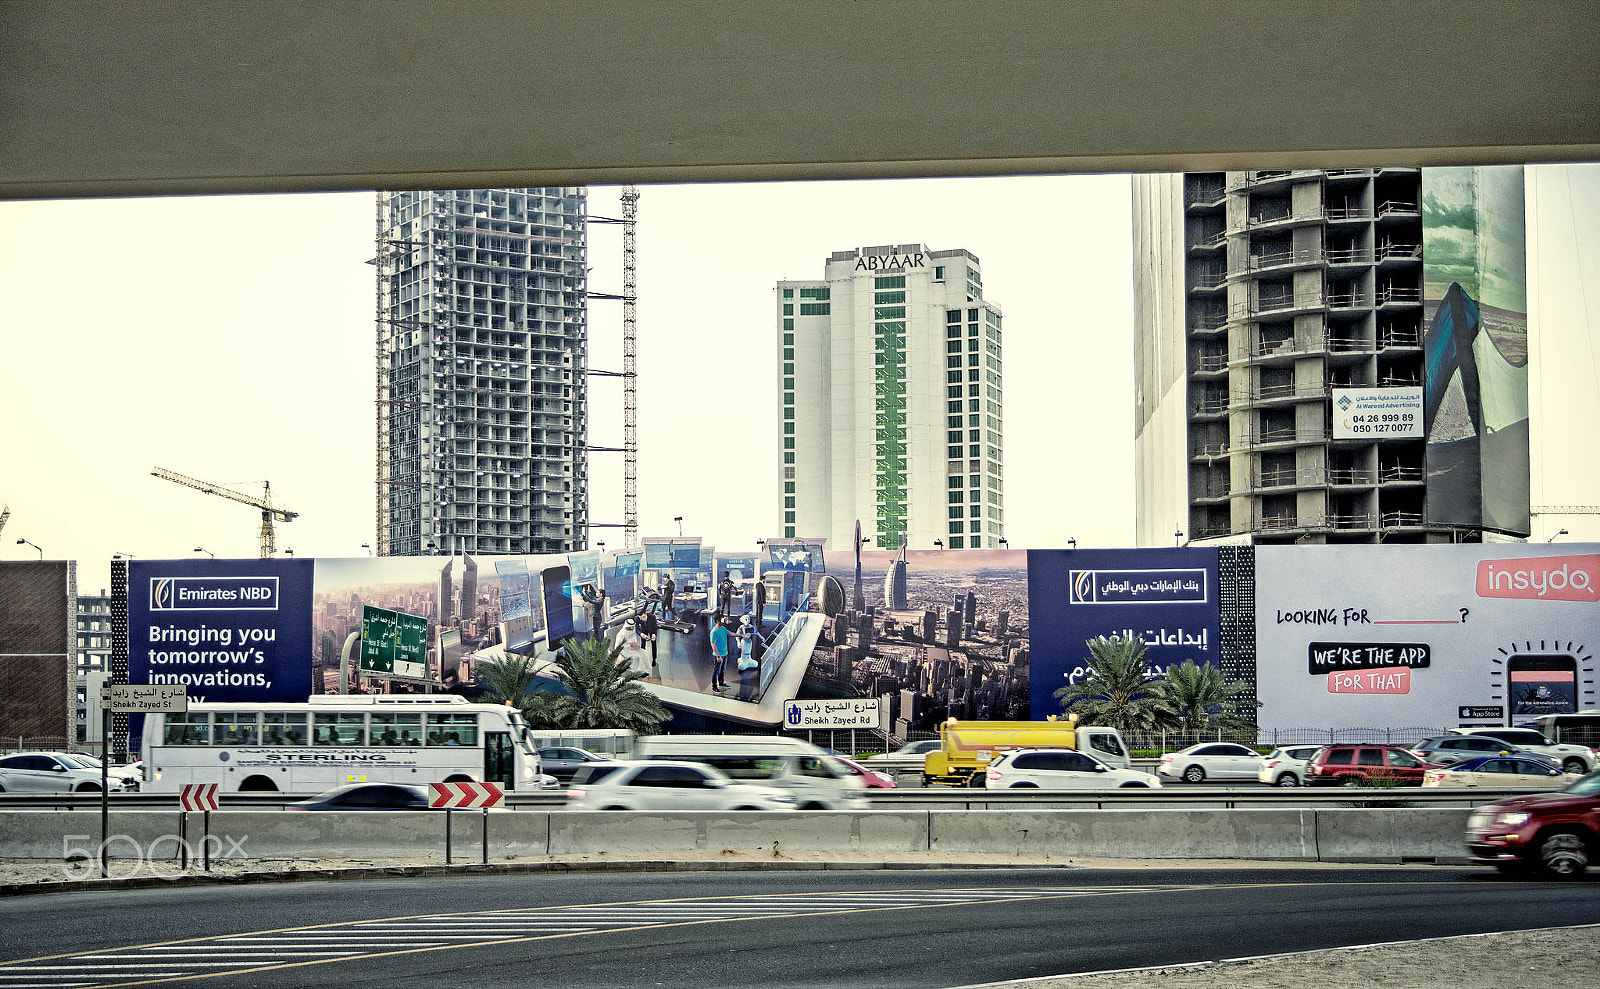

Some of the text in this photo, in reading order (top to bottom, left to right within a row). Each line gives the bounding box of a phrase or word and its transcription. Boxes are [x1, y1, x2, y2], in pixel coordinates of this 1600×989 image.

[855, 253, 925, 271] ABYAAR
[1352, 413, 1414, 423] 04 26 999 89
[1352, 423, 1414, 433] 050 127 0077
[1101, 579, 1199, 596] بنك الإمارات دبي الوطني
[1488, 563, 1595, 597] insydo
[179, 587, 272, 600] Emirates NBD
[1276, 608, 1338, 625] LOOKING
[1342, 607, 1371, 626] FOR
[149, 624, 277, 646] Bringing you
[148, 647, 265, 664] tomorrow's
[1313, 647, 1426, 665] WE'RE THE APP
[148, 669, 272, 689] innovations,
[1334, 672, 1407, 692] FOR THAT
[112, 688, 185, 699] شارع الشيخ زايد
[112, 700, 137, 708] Sheikh
[138, 701, 161, 709] Zayed
[804, 702, 877, 713] شارع الشيخ زايد
[790, 713, 799, 723] 11
[804, 716, 871, 726] Sheikh Zayed Rd
